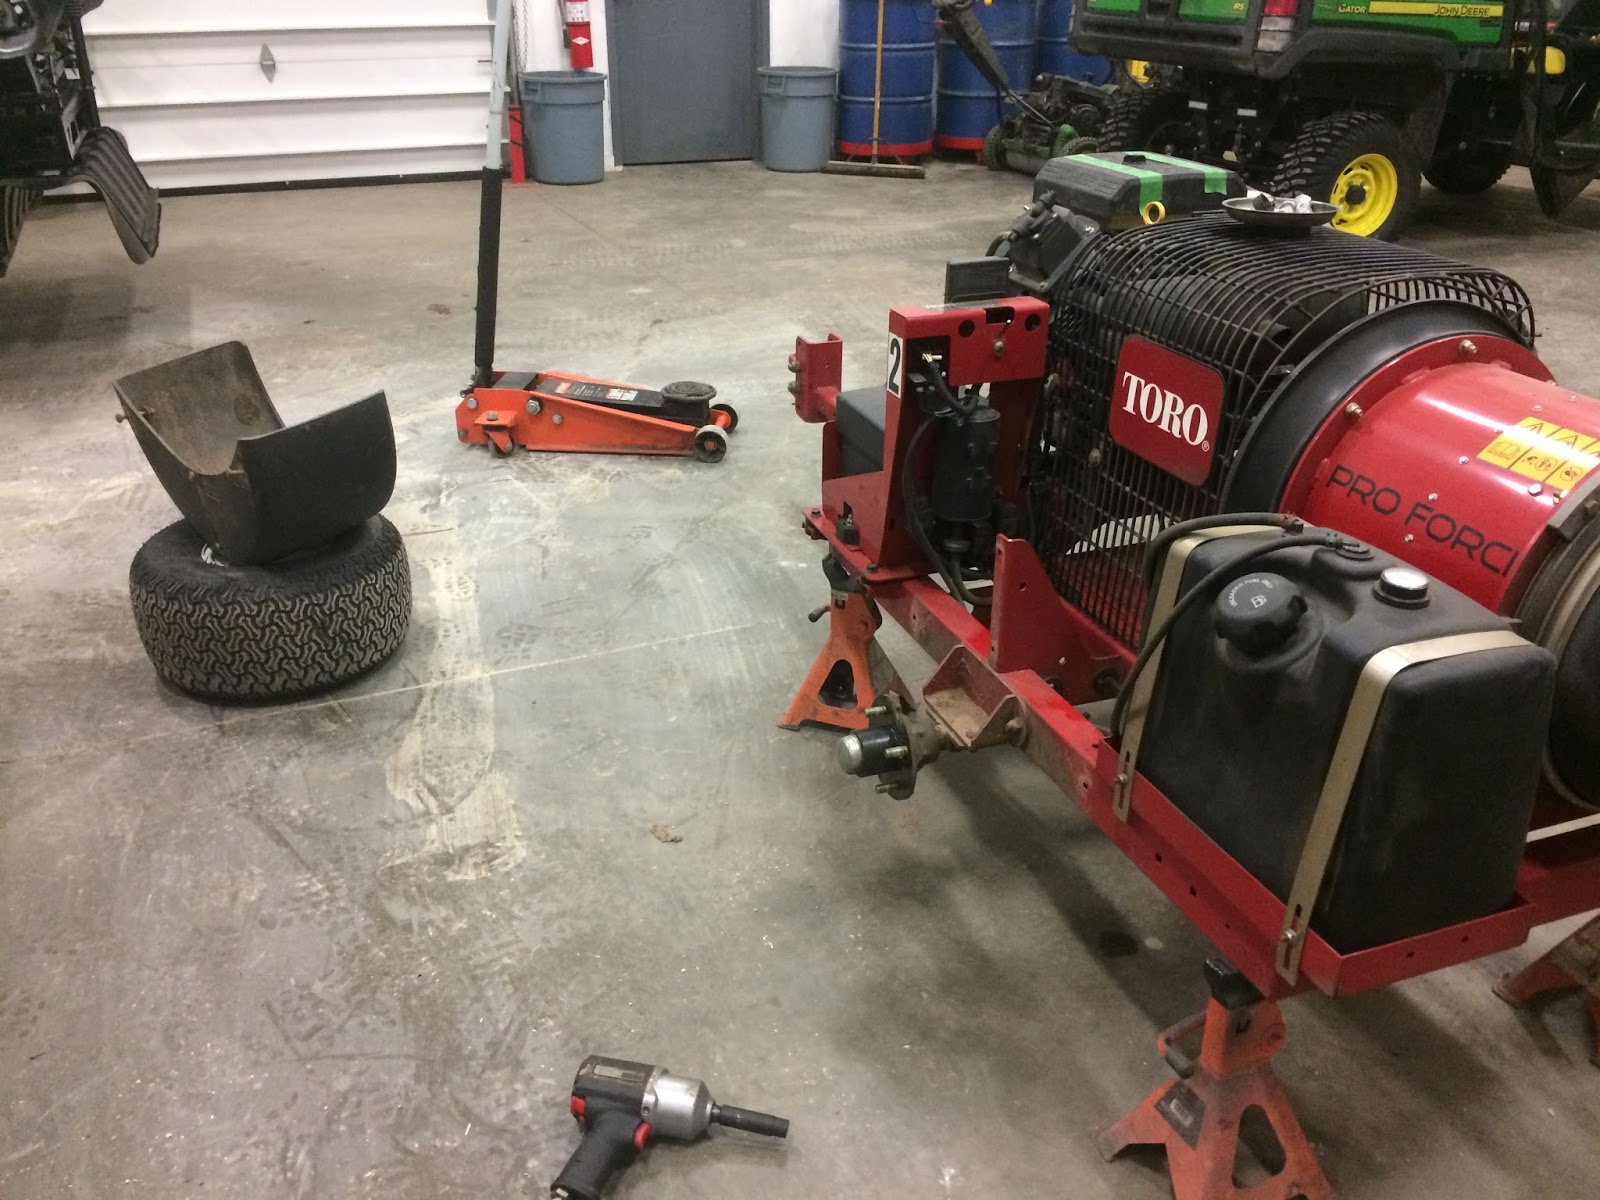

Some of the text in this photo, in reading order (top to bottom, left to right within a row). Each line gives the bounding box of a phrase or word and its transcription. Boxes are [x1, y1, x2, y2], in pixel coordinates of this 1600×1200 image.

[1338, 4, 1367, 14] GATOR
[1434, 4, 1490, 16] JOHN DEERE
[889, 338, 901, 395] 2
[1122, 371, 1208, 446] TORO
[1326, 464, 1401, 515] PRO
